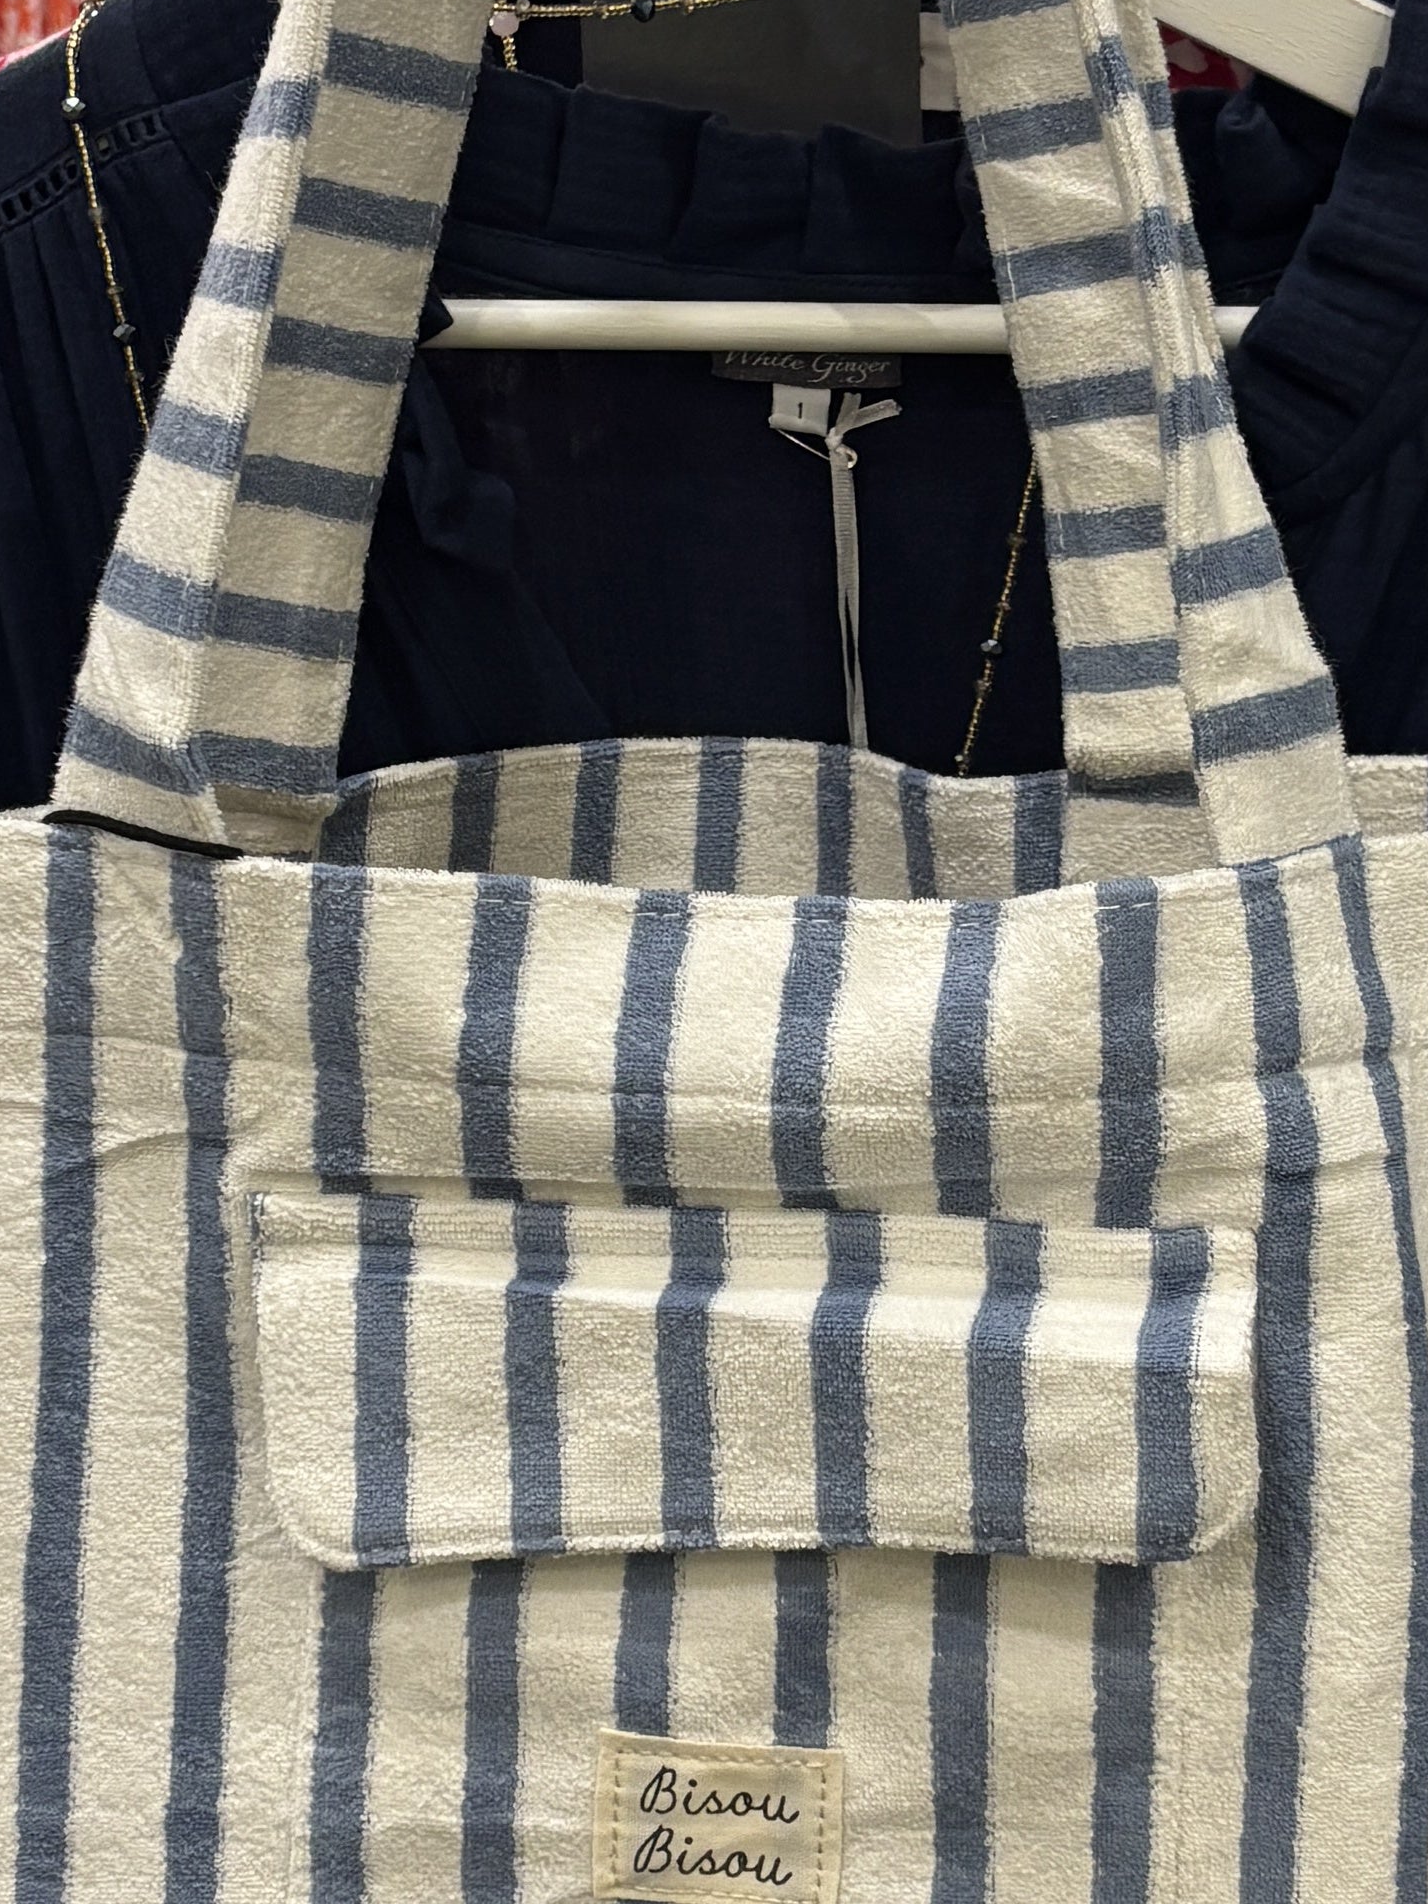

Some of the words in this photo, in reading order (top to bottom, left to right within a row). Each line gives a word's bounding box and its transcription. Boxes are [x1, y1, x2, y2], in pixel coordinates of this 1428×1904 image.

[724, 350, 806, 370] White
[807, 352, 891, 384] Ginger
[797, 401, 804, 420] 1
[638, 1764, 801, 1824] Bisou
[632, 1823, 794, 1886] Bisou
